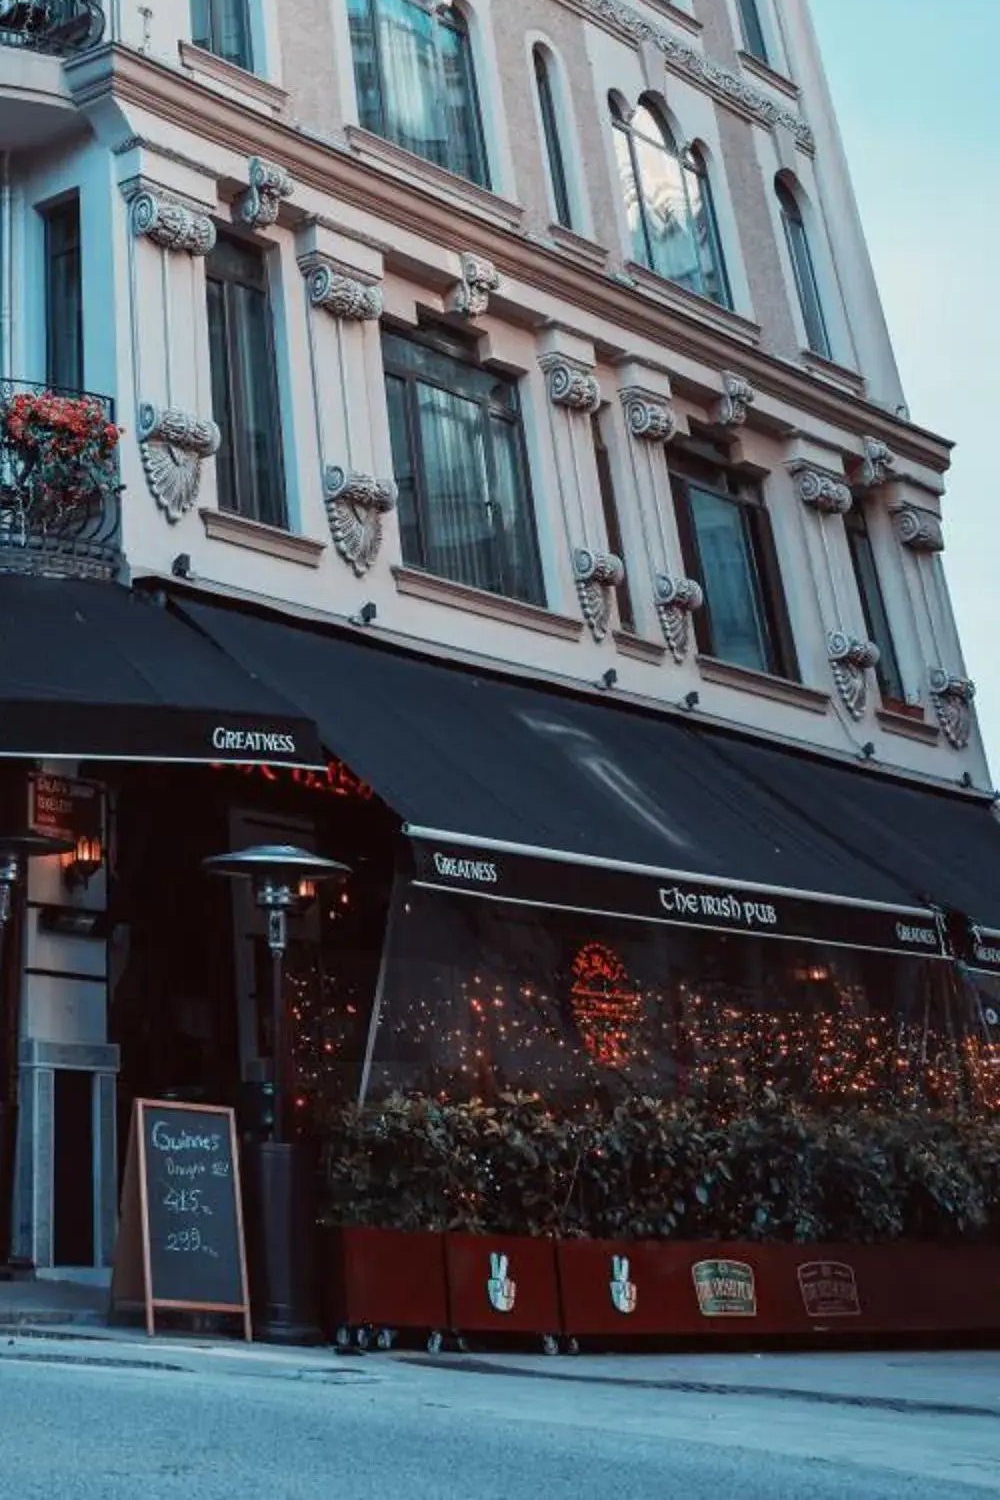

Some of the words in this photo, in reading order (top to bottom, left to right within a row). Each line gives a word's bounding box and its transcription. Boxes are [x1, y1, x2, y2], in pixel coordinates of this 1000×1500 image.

[212, 727, 295, 752] GREATNESS
[432, 851, 498, 884] GREATNESS
[658, 886, 699, 914] The
